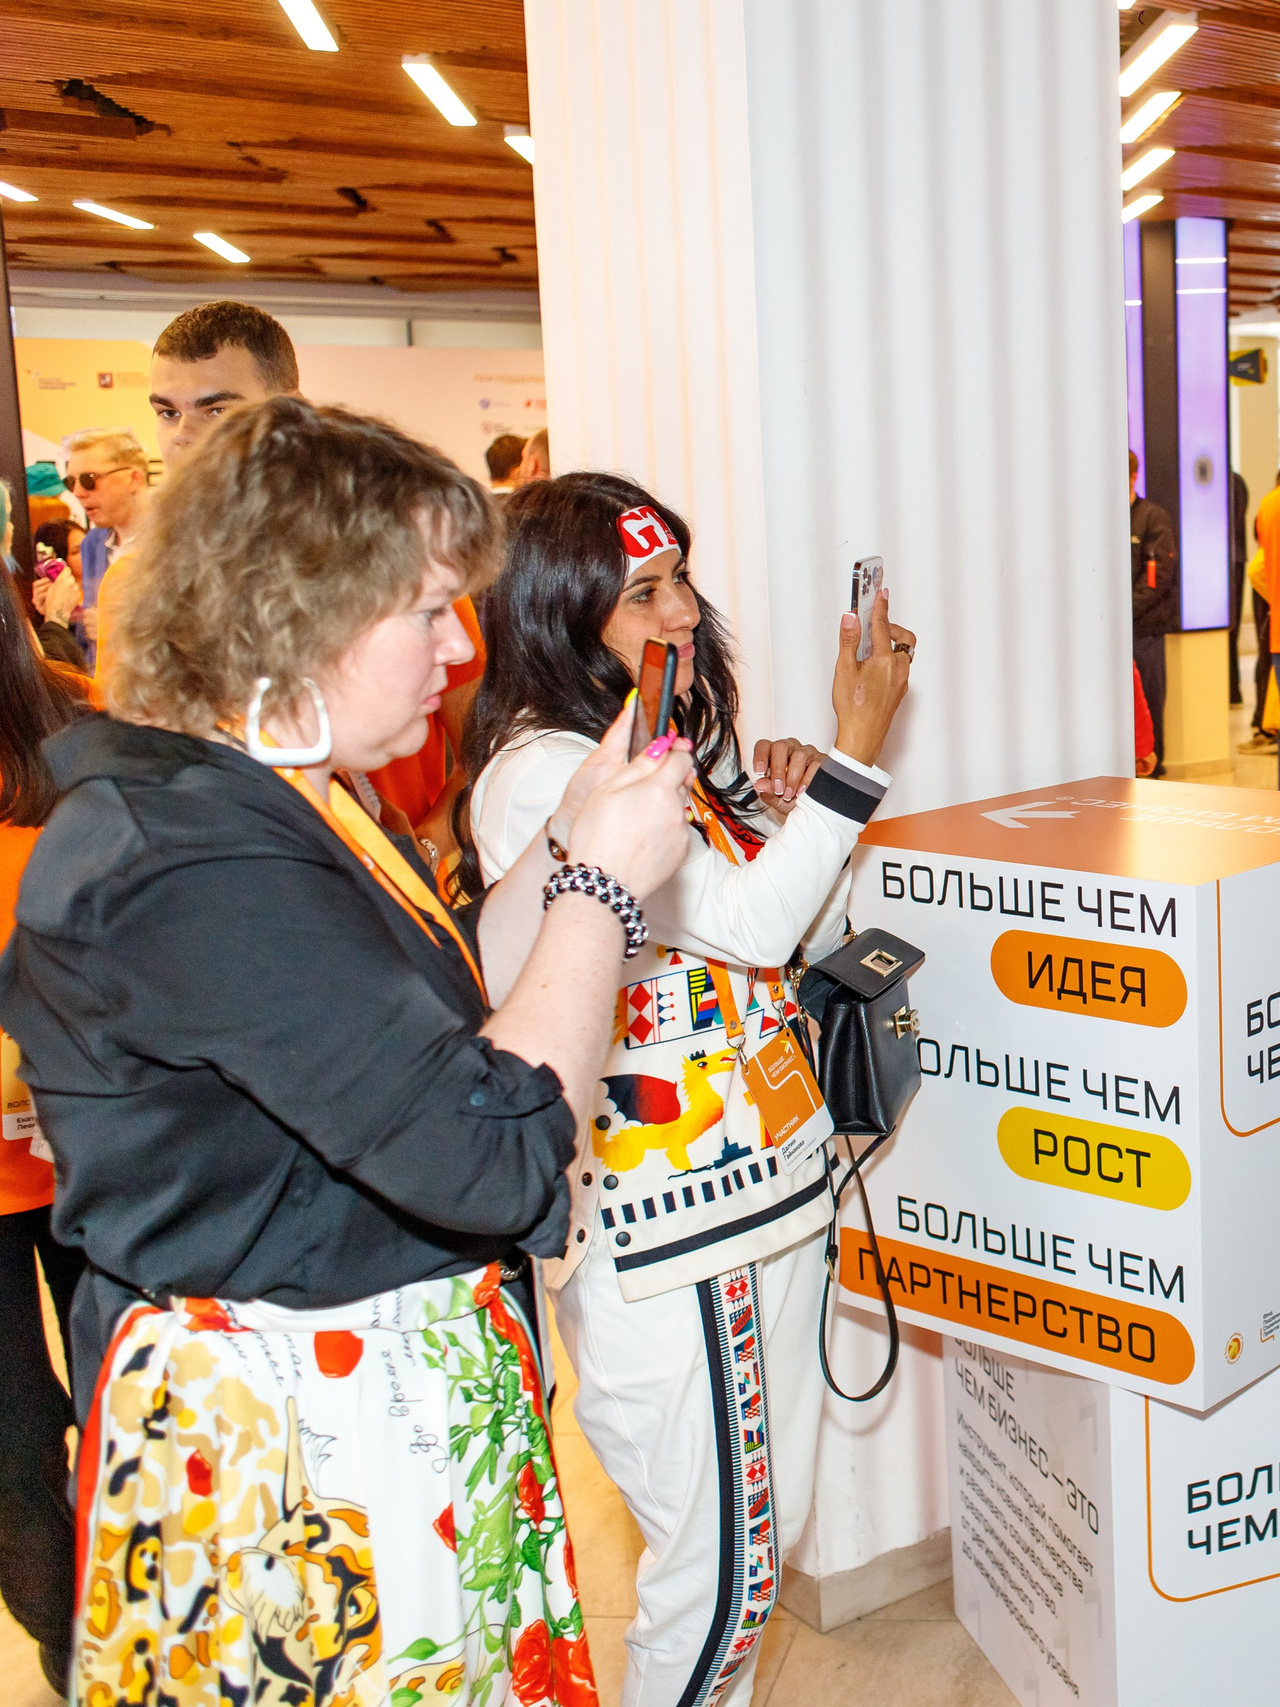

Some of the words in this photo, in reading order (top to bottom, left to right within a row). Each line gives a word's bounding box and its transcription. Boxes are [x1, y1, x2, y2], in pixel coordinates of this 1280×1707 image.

[882, 860, 1065, 923] БОЛЬШЕ
[1077, 885, 1177, 939] ЧЕМ
[1026, 950, 1148, 1008] ИДЕЯ
[918, 1036, 1071, 1104] ОЛЬШЕ
[1081, 1060, 1181, 1127] ЧЕМ
[774, 1115, 800, 1142] УЧАСТНИК
[1032, 1127, 1152, 1190] РОСТ
[896, 1195, 1075, 1277] БОЛЬШЕ
[1088, 1242, 1185, 1304] ЧЕМ
[857, 1247, 1157, 1365] ПАРТНЕРСТВО
[956, 1358, 985, 1410] ЧЕМ
[987, 1392, 1049, 1479] БИЗНЕС
[1067, 1477, 1099, 1536] ЭТО
[1187, 1507, 1279, 1557] ЧЕМ
